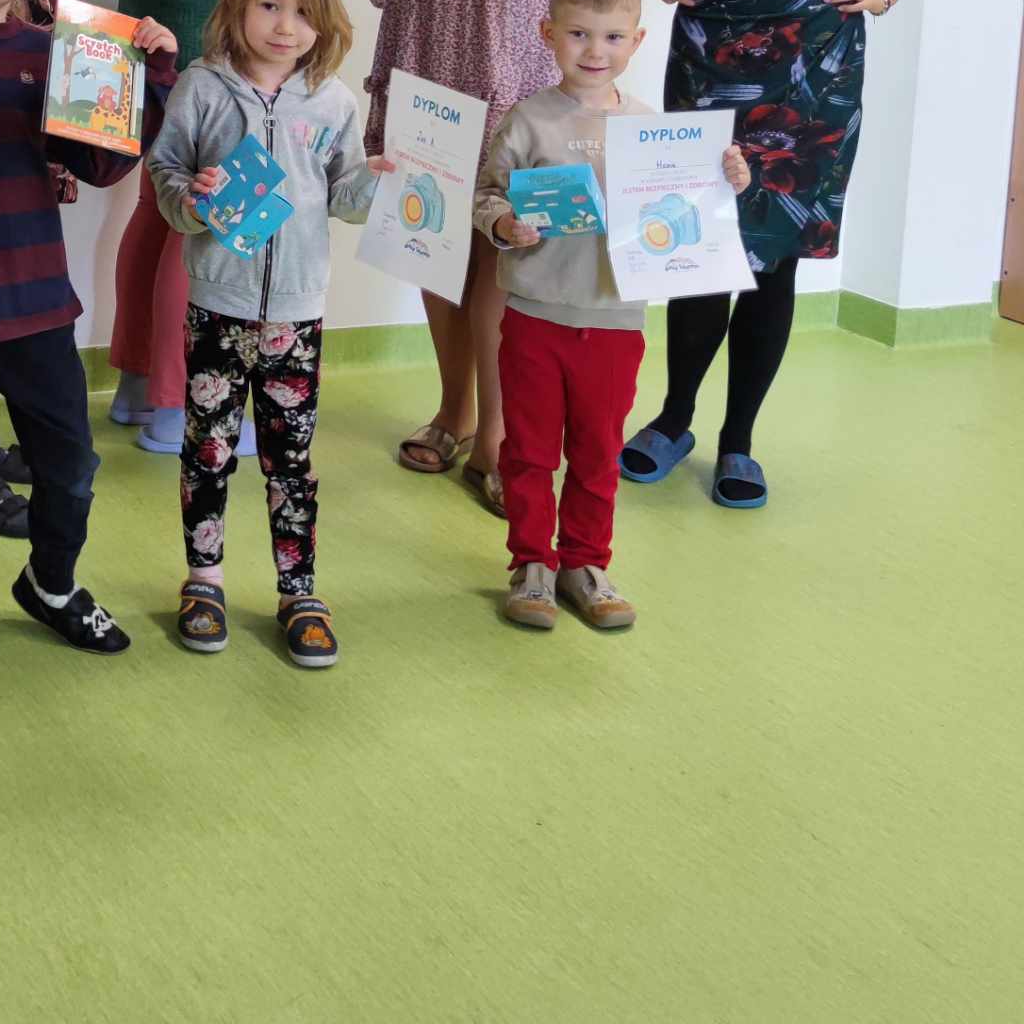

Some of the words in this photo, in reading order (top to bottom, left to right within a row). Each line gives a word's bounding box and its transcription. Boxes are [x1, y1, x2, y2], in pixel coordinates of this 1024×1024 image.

[77, 35, 121, 55] Scratch
[413, 95, 460, 125] DYPLOM
[639, 127, 702, 144] DYPLOM
